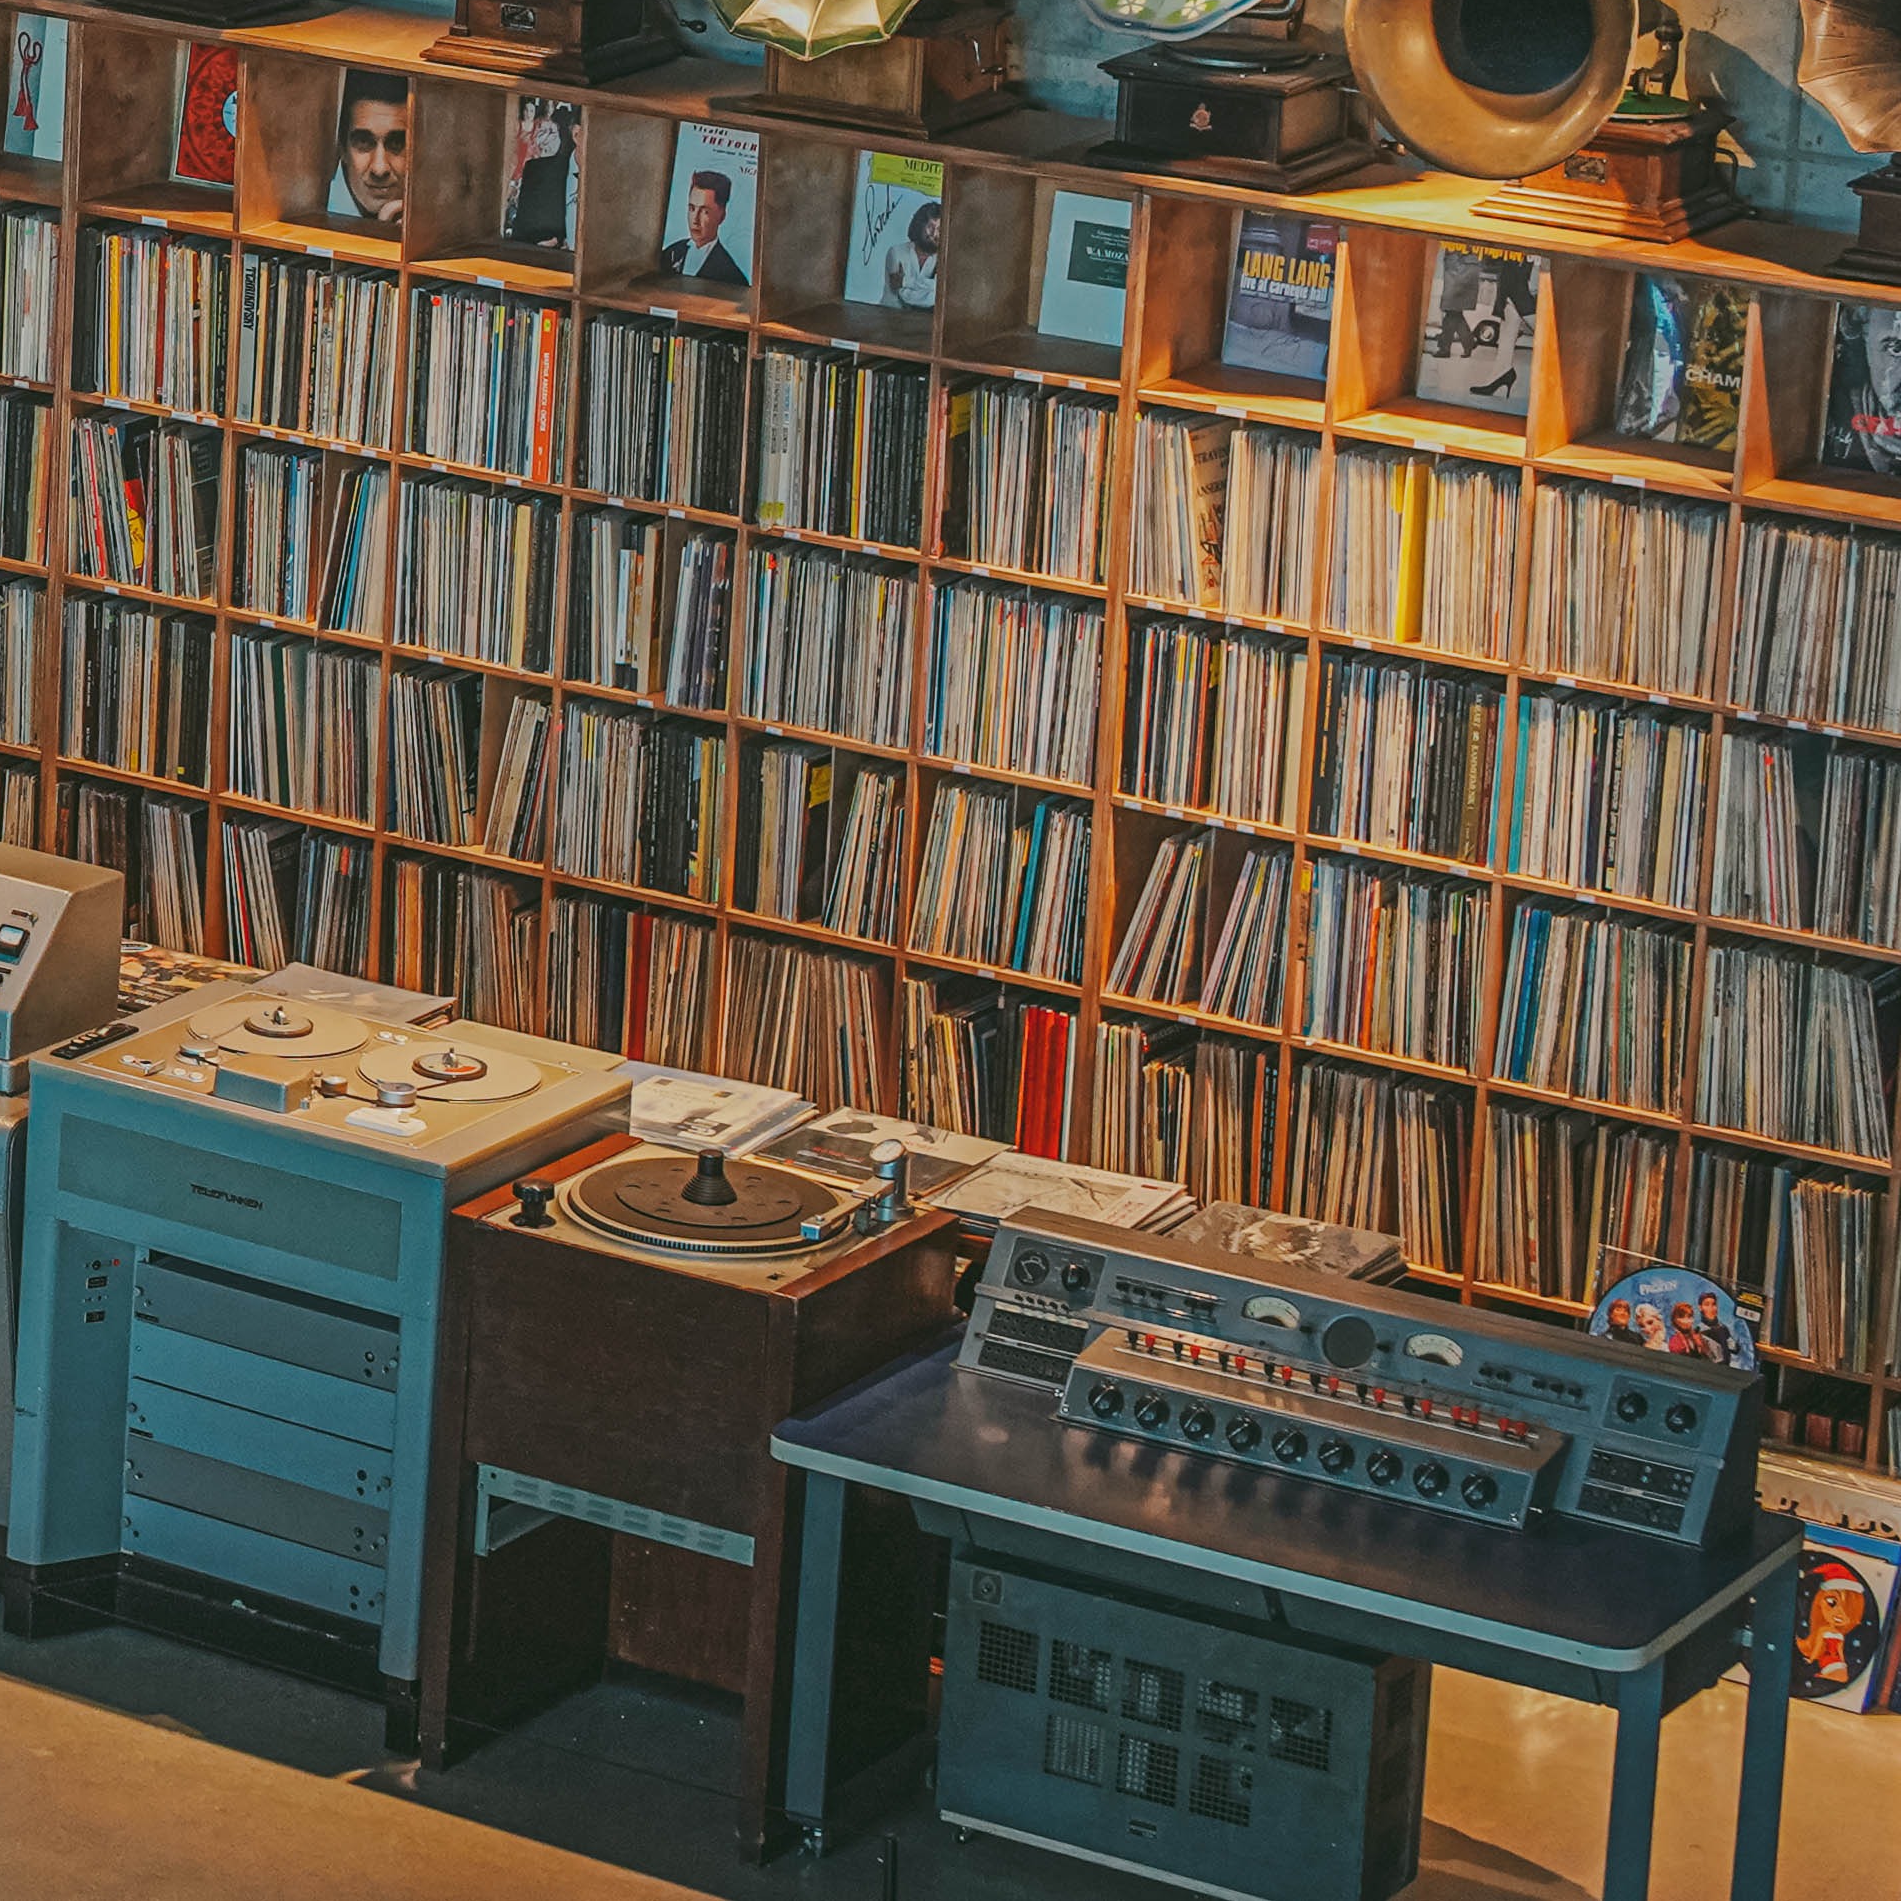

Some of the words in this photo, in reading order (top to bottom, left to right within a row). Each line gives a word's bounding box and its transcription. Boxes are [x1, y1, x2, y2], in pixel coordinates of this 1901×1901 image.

[693, 124, 728, 136] Vivaldi
[702, 135, 723, 146] THE
[1242, 250, 1285, 281] LANG
[1288, 257, 1331, 289] LANG
[243, 266, 257, 331] TCHAIKOVSKY
[190, 1183, 264, 1210] TELEFUNKEN
